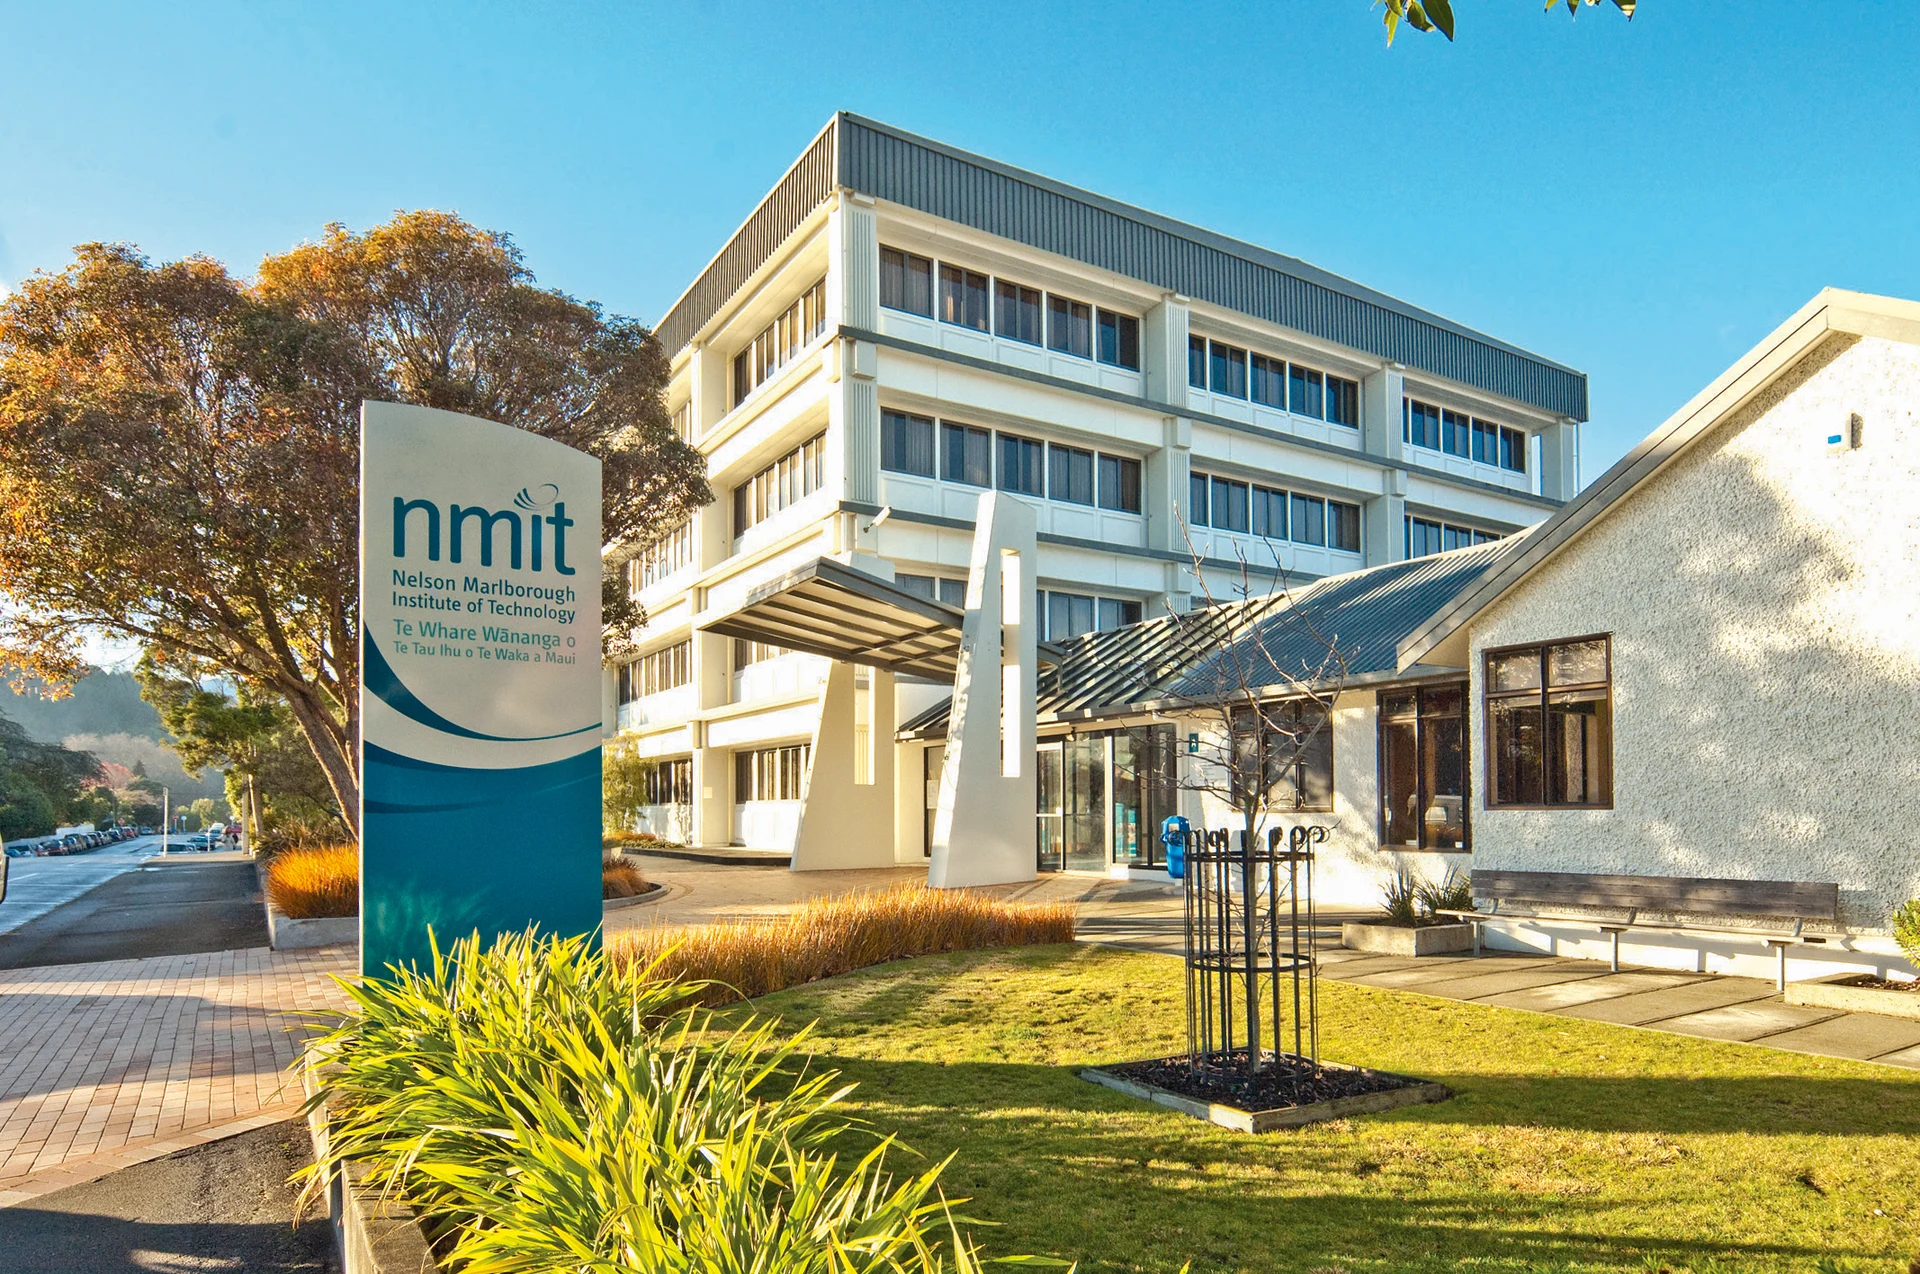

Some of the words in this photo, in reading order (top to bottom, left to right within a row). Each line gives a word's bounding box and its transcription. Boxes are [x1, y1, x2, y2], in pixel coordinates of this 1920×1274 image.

[393, 496, 576, 576] nmit
[393, 569, 456, 592] Nelson
[463, 576, 576, 605] Marlborough
[393, 591, 462, 611] Institute
[467, 598, 484, 613] of
[487, 600, 576, 624] Technology
[393, 619, 413, 636] Te
[419, 621, 477, 641] Whare
[482, 625, 561, 650] Wānanga
[567, 636, 576, 648] o
[393, 641, 408, 654] Te
[412, 642, 436, 656] Tau
[440, 644, 461, 657] Ihu
[465, 649, 474, 658] o
[477, 647, 492, 660] Te
[495, 648, 530, 662] Waka
[534, 653, 541, 663] a
[545, 651, 576, 665] Maui
